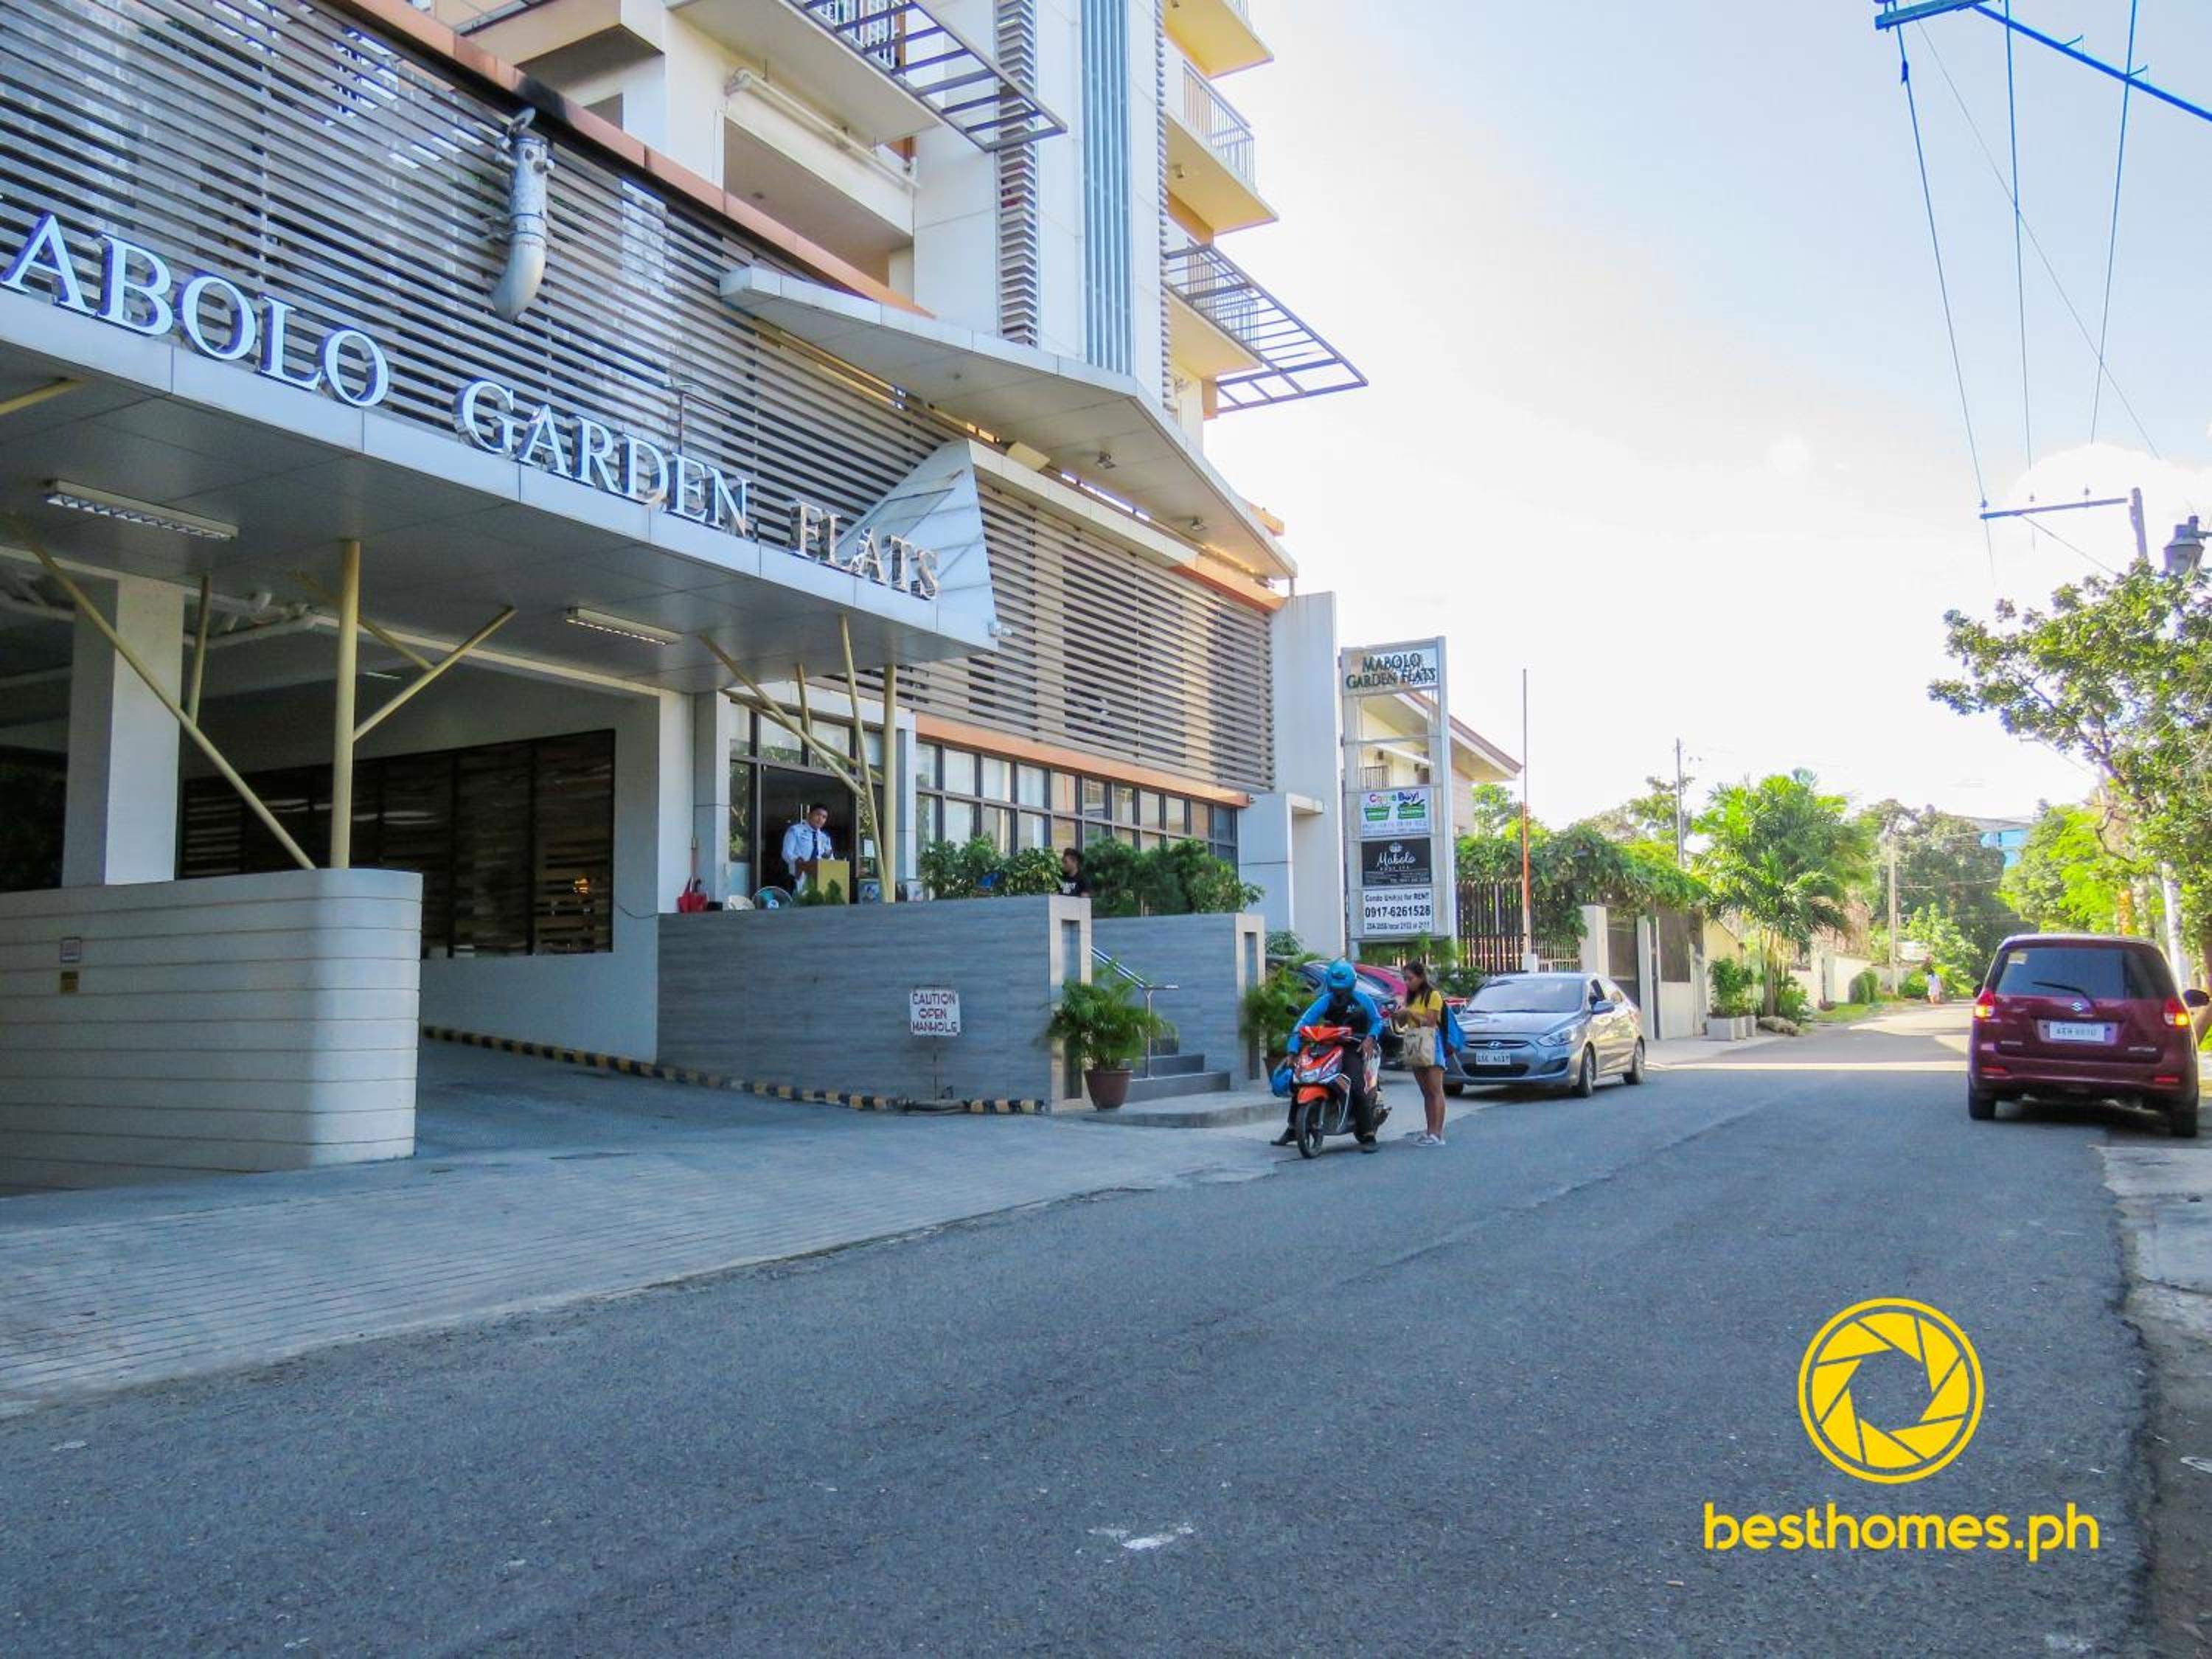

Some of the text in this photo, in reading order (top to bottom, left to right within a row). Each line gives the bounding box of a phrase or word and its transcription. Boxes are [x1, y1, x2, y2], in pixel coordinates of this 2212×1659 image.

[0, 209, 941, 601] ABOLO GARDEN FLATS
[1362, 653, 1421, 672] MABOLO
[1346, 667, 1436, 689] GARDEN FLATS
[1376, 852, 1416, 868] Mabolo
[913, 992, 956, 1004] CAUTION
[919, 1008, 947, 1019] OPEN
